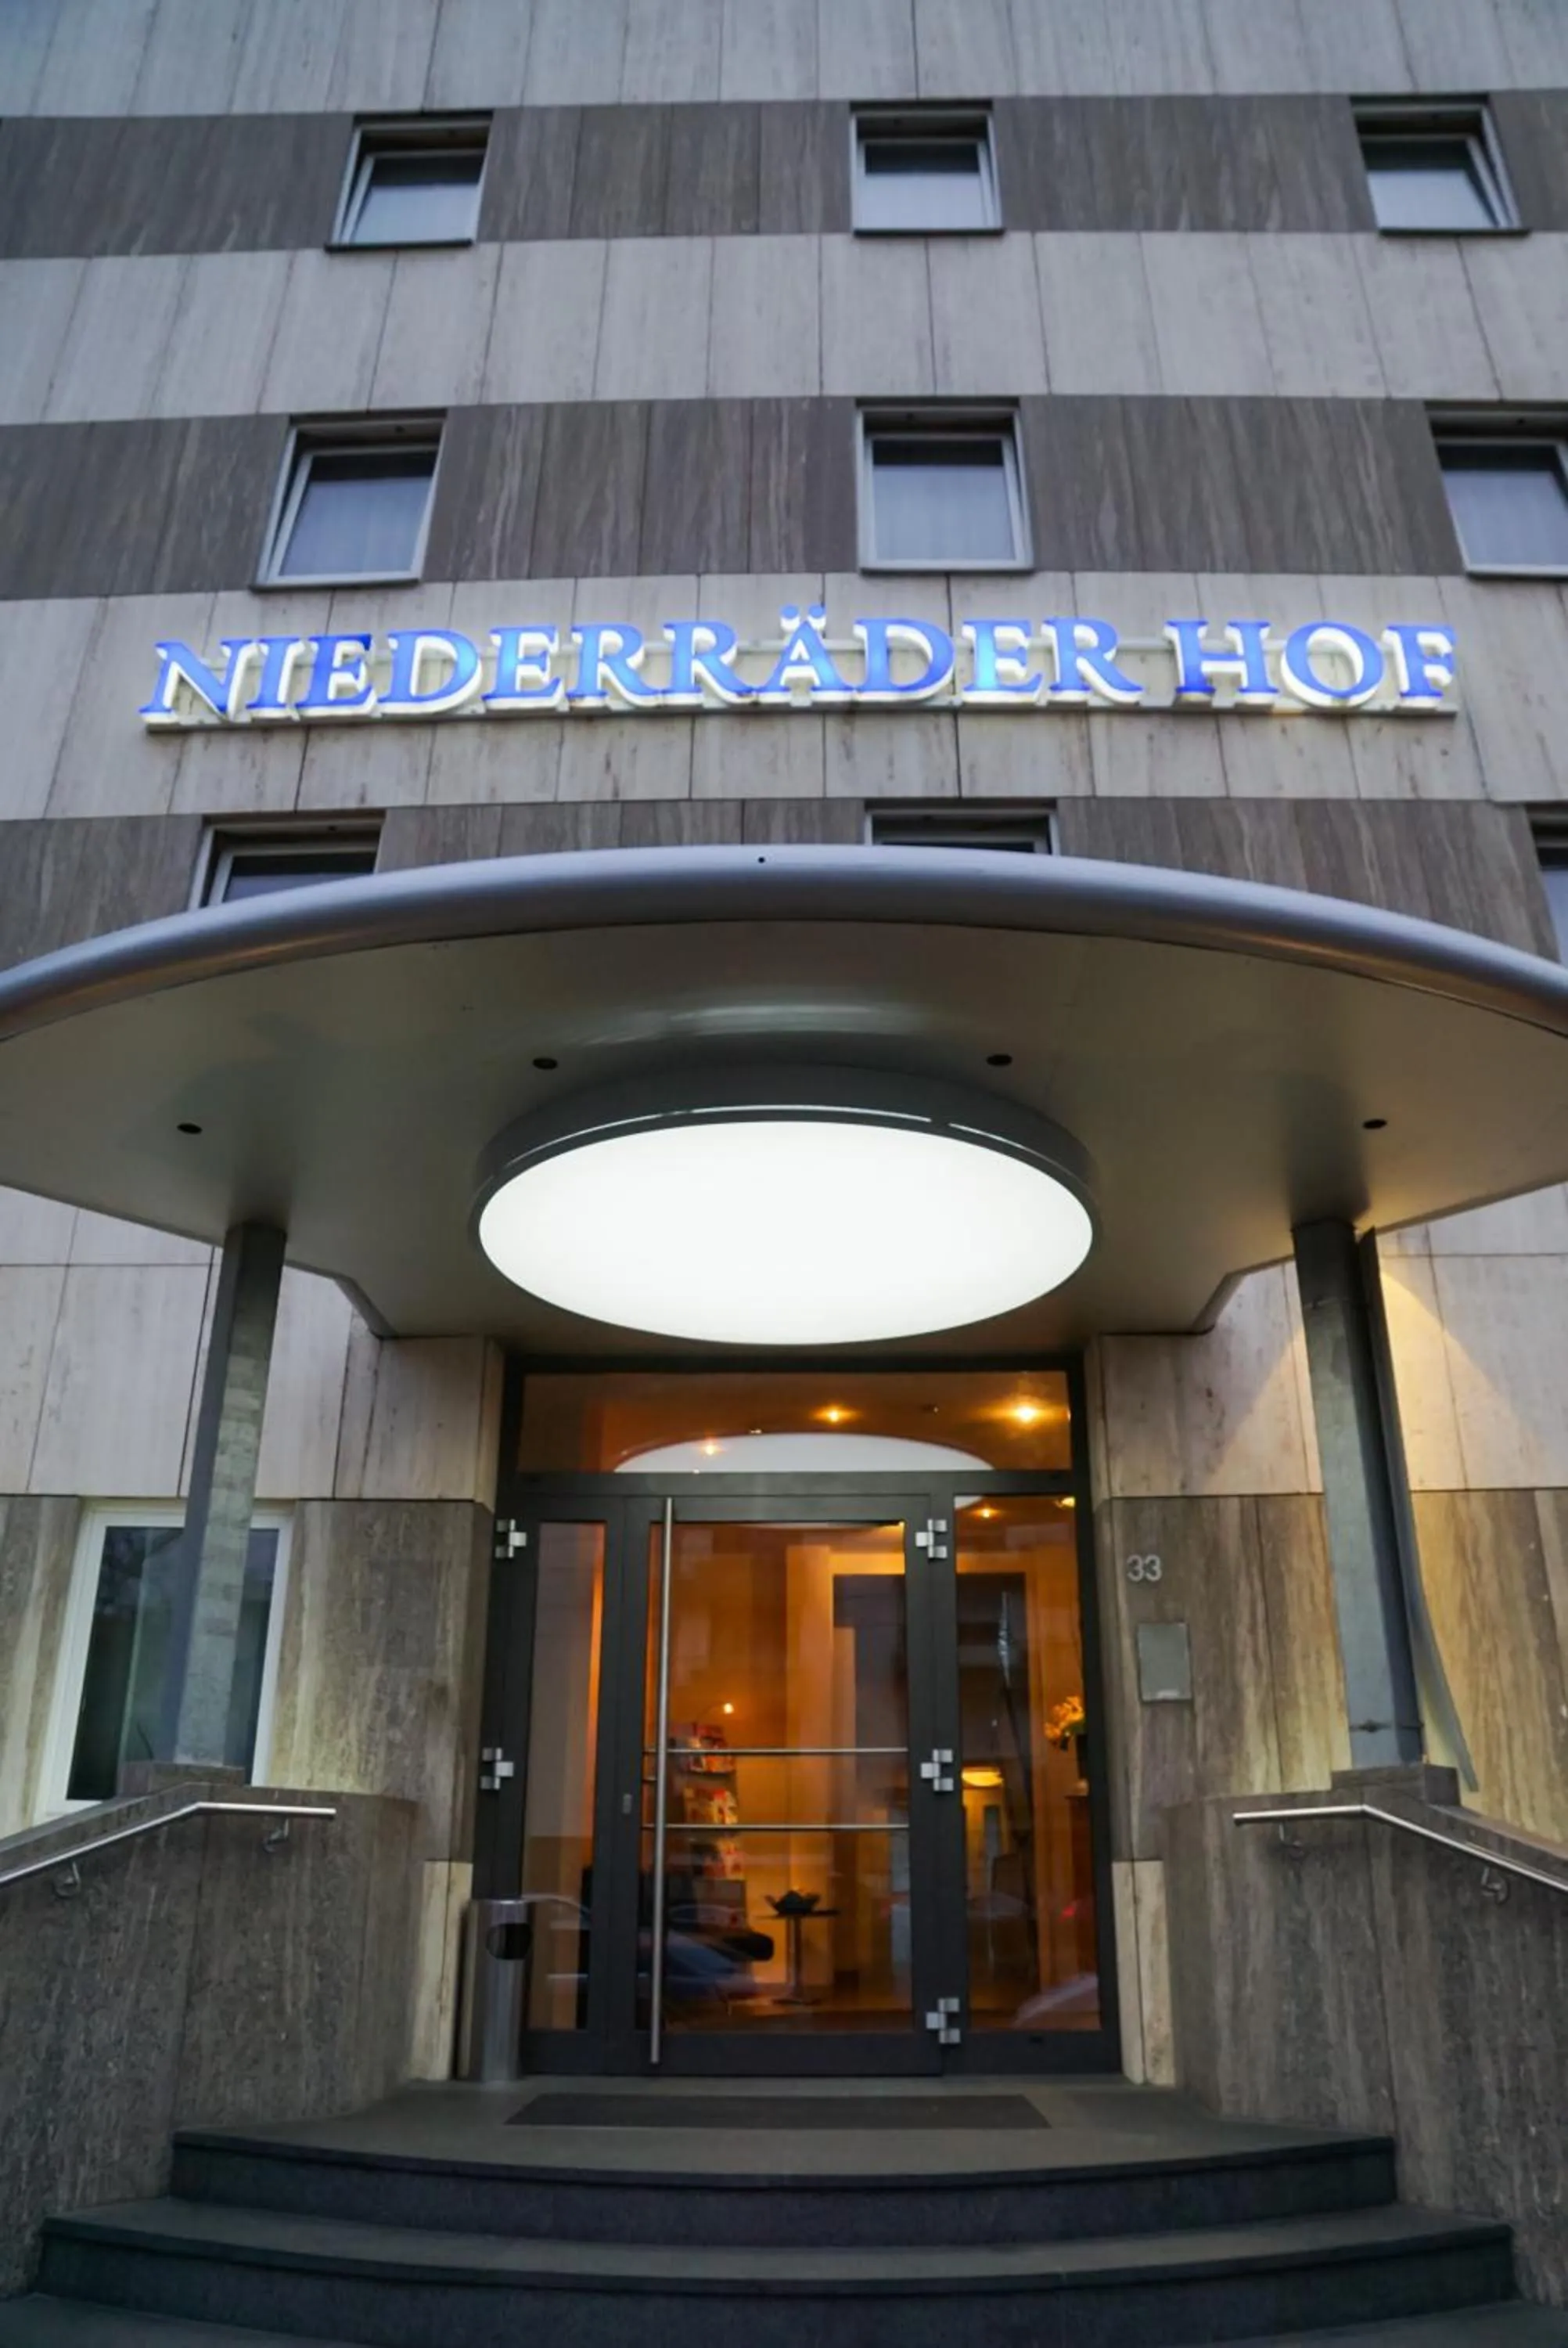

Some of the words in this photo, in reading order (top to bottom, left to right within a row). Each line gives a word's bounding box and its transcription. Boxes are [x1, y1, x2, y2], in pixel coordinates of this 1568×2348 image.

[139, 604, 1143, 723] NIEDERRÄDER
[1164, 619, 1457, 709] HOF
[1127, 1554, 1162, 1582] 33
